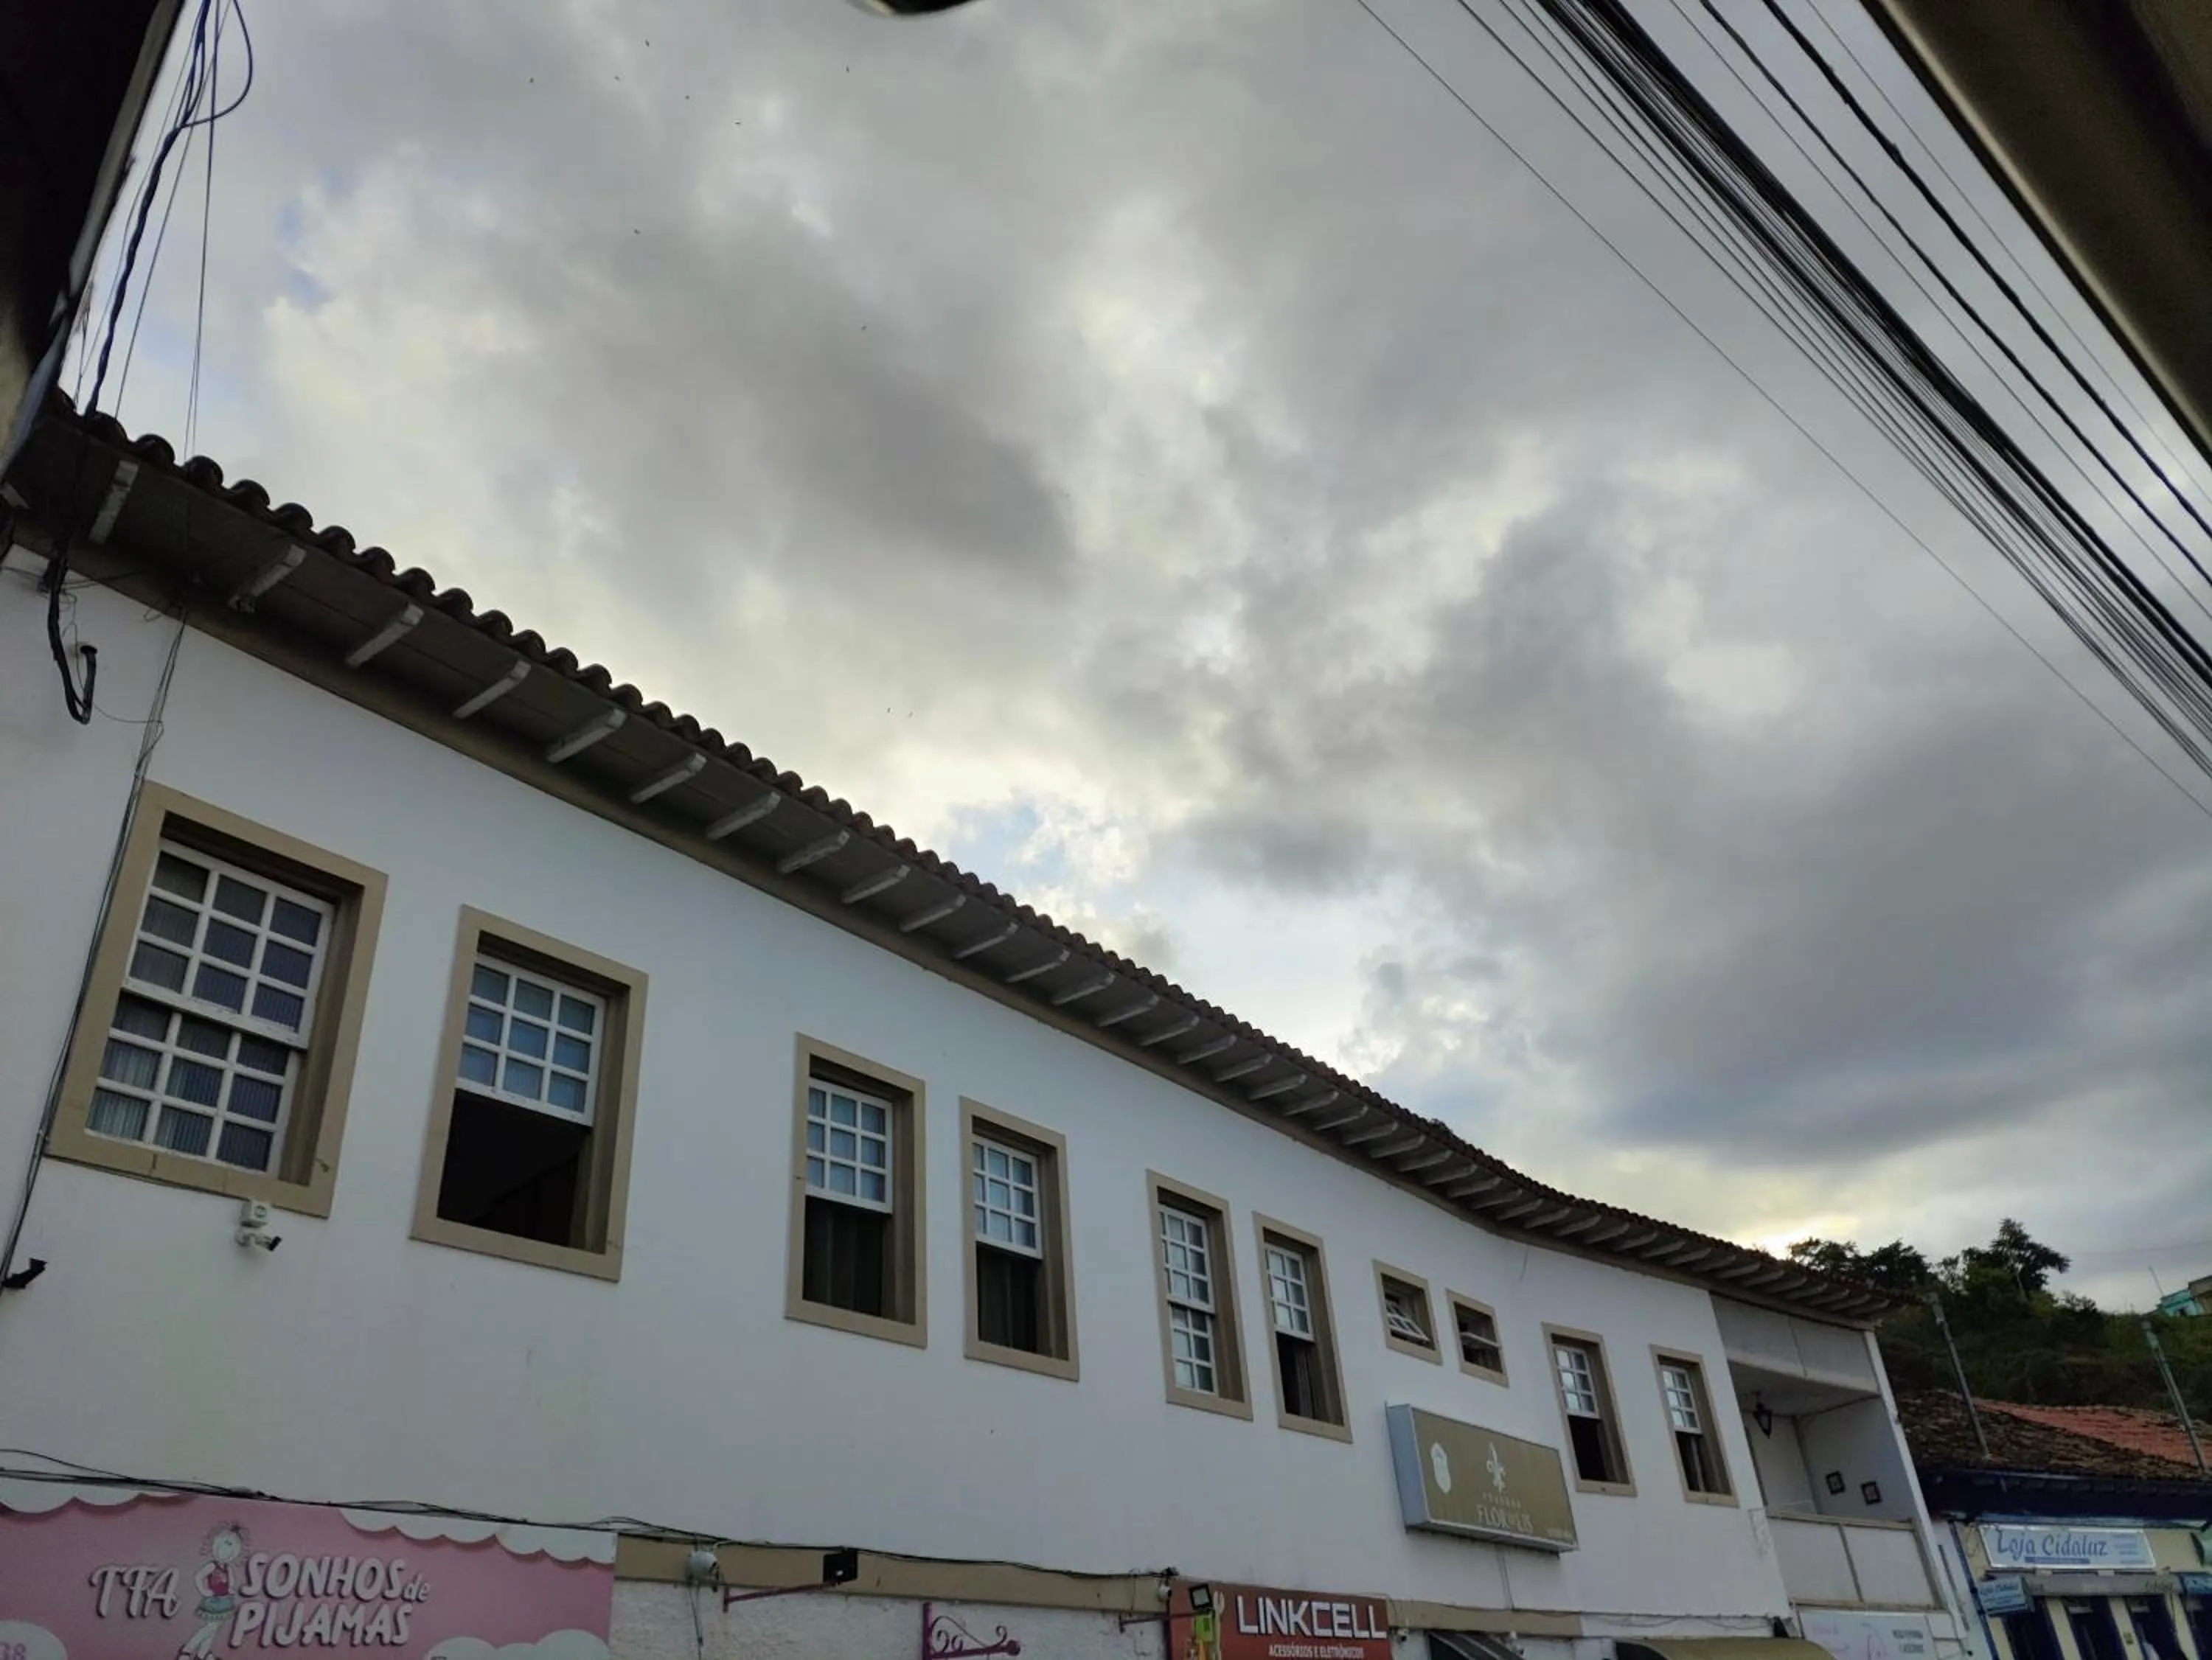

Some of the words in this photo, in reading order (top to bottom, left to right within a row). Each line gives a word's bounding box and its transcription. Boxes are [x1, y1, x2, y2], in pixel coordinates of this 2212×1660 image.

[1994, 1524, 2036, 1560] Loja
[2042, 1532, 2109, 1557] Cidaluz
[238, 1552, 407, 1600] SONHOS
[403, 1572, 431, 1603] de
[228, 1601, 414, 1648] PIJAMAS
[1237, 1594, 1388, 1640] LINKCELL
